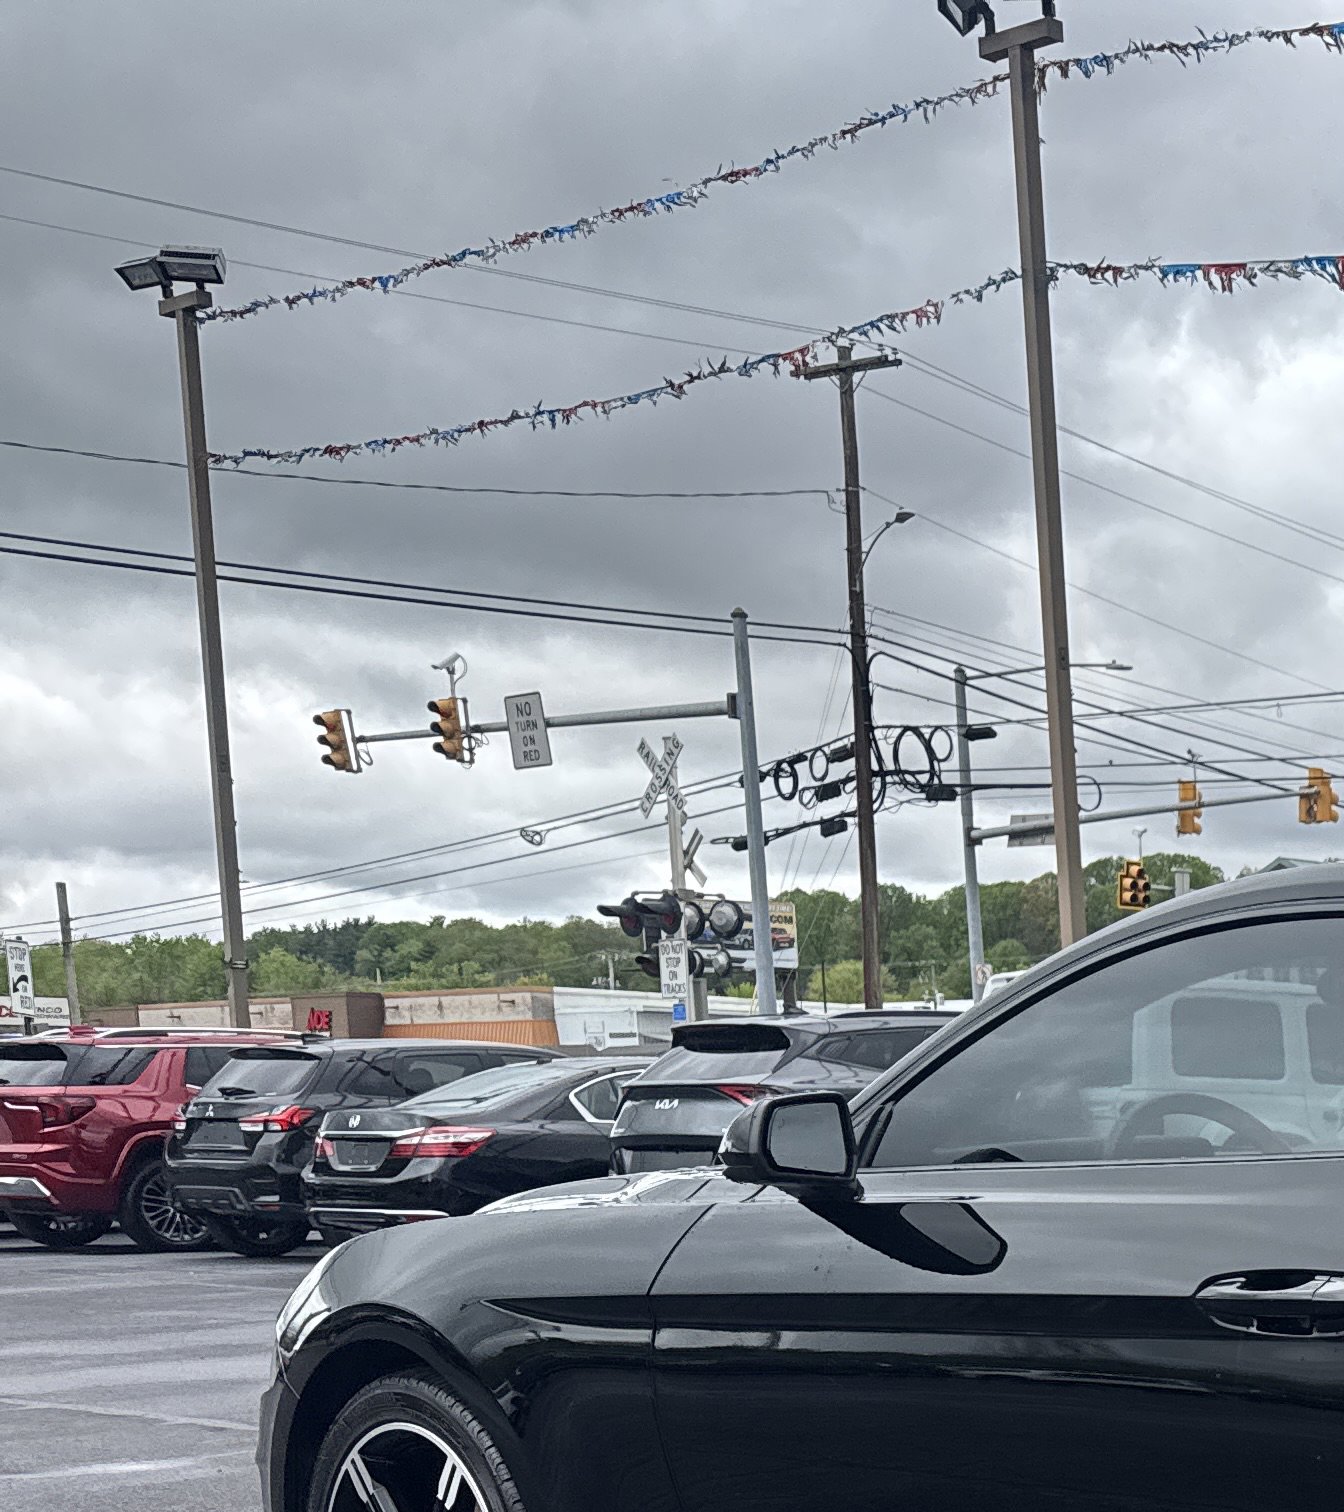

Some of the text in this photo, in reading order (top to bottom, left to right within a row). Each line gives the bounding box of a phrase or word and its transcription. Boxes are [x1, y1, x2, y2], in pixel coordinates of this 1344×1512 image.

[516, 702, 532, 717] NO
[515, 720, 538, 732] TURN
[522, 736, 536, 747] ON
[523, 750, 540, 762] RED
[640, 737, 681, 813] CROSSING
[9, 946, 27, 962] STOP
[661, 942, 684, 956] DO NOT
[666, 957, 681, 968] STOP
[669, 970, 678, 980] ON
[663, 983, 686, 995] TRACKS
